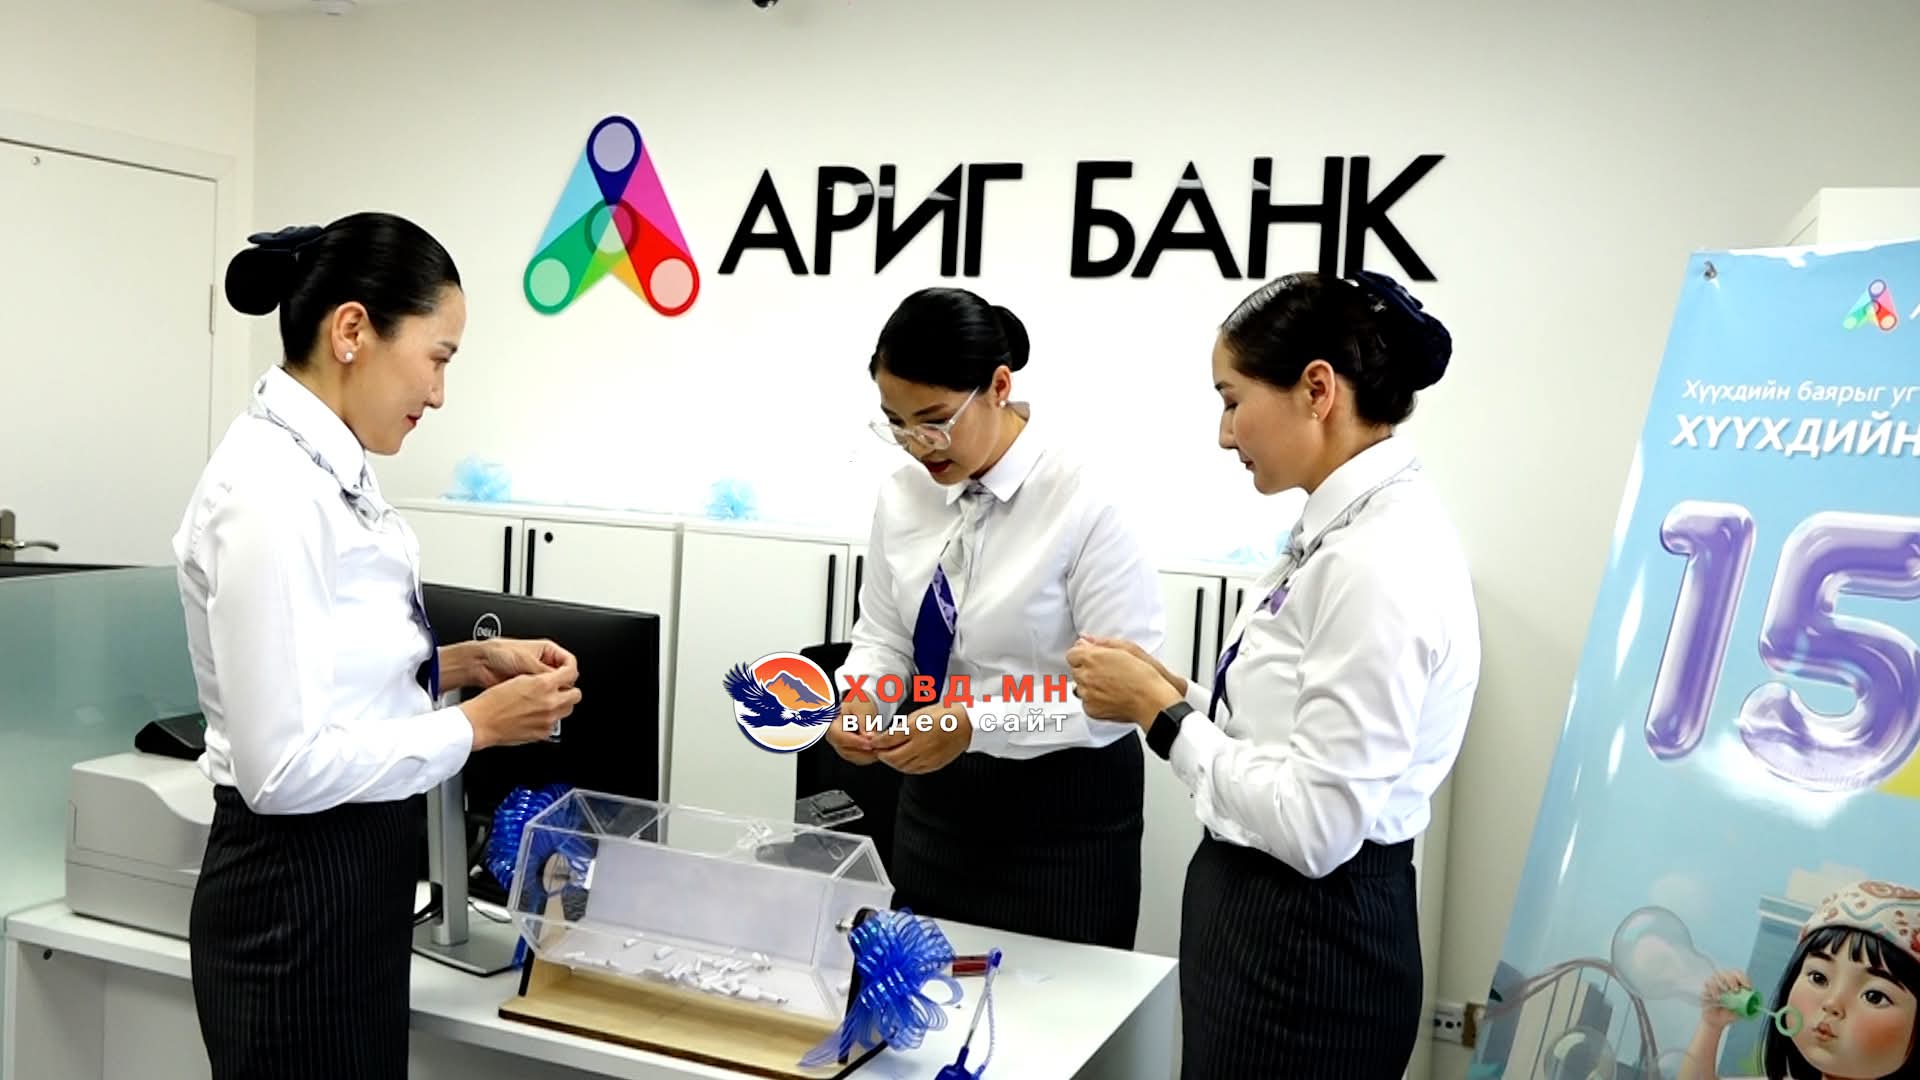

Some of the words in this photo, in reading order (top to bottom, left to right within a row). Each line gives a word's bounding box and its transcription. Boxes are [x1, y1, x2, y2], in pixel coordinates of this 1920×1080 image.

[717, 161, 1023, 277] АРИГ
[1070, 154, 1446, 282] БАНК
[1671, 411, 1920, 458] ХҮҮХДИЙН
[1797, 380, 1886, 406] баярыг
[1645, 500, 1920, 793] 15
